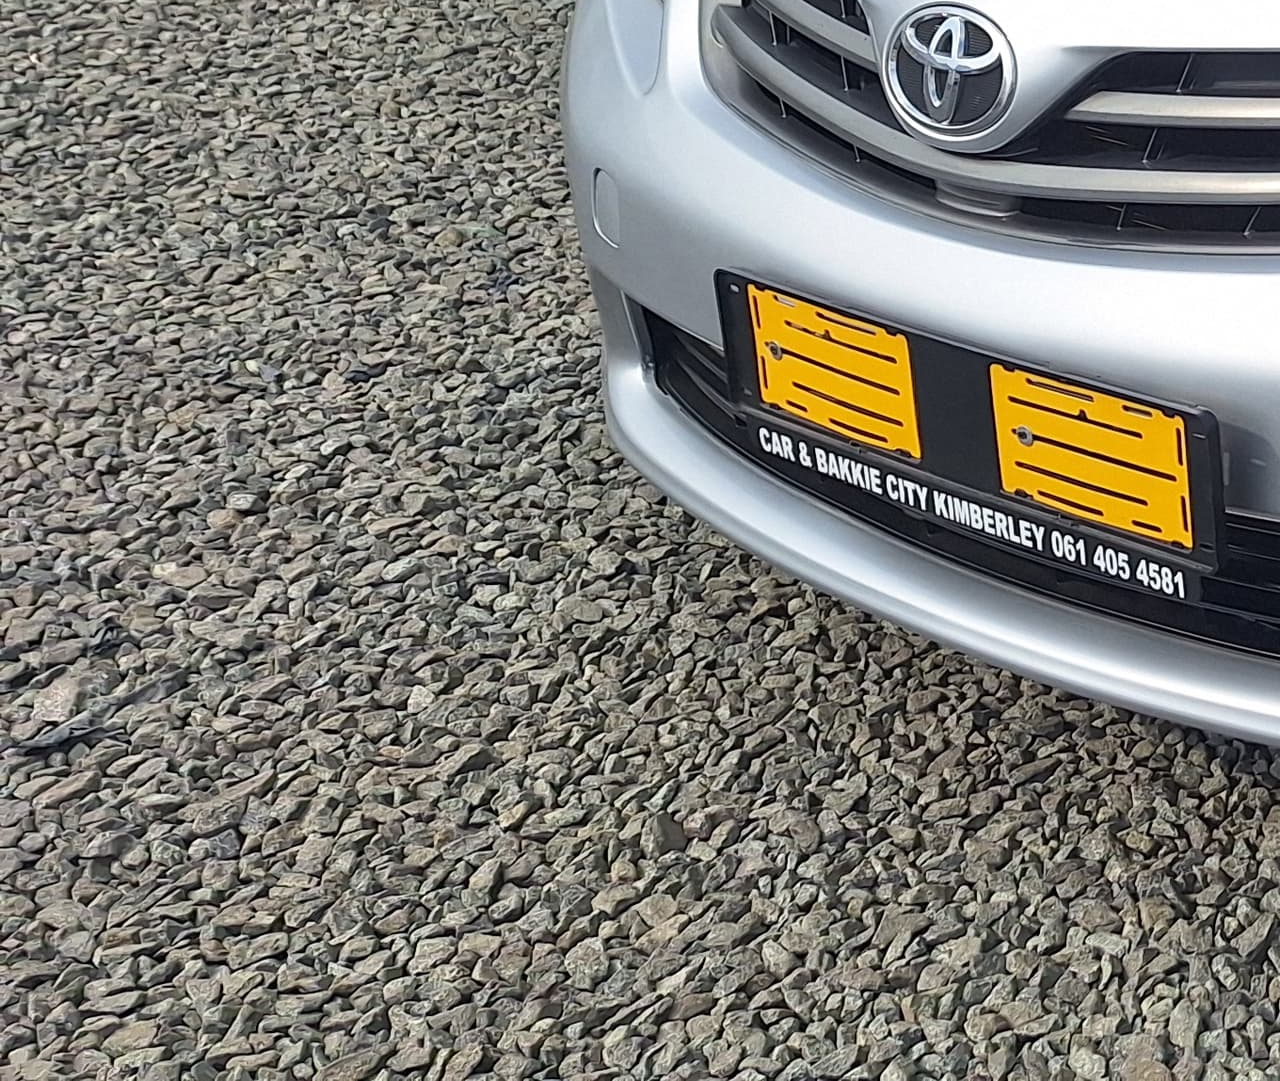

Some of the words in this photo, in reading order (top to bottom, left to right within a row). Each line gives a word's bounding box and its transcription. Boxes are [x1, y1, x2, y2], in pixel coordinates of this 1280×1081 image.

[758, 427, 795, 461] CAR
[799, 442, 812, 468] &
[814, 447, 883, 495] BAKKIE
[886, 474, 928, 511] CITY
[933, 490, 1045, 552] KIMBERLEY
[1051, 530, 1087, 565] 061
[1093, 545, 1130, 580] 405
[1136, 559, 1185, 598] 4581
